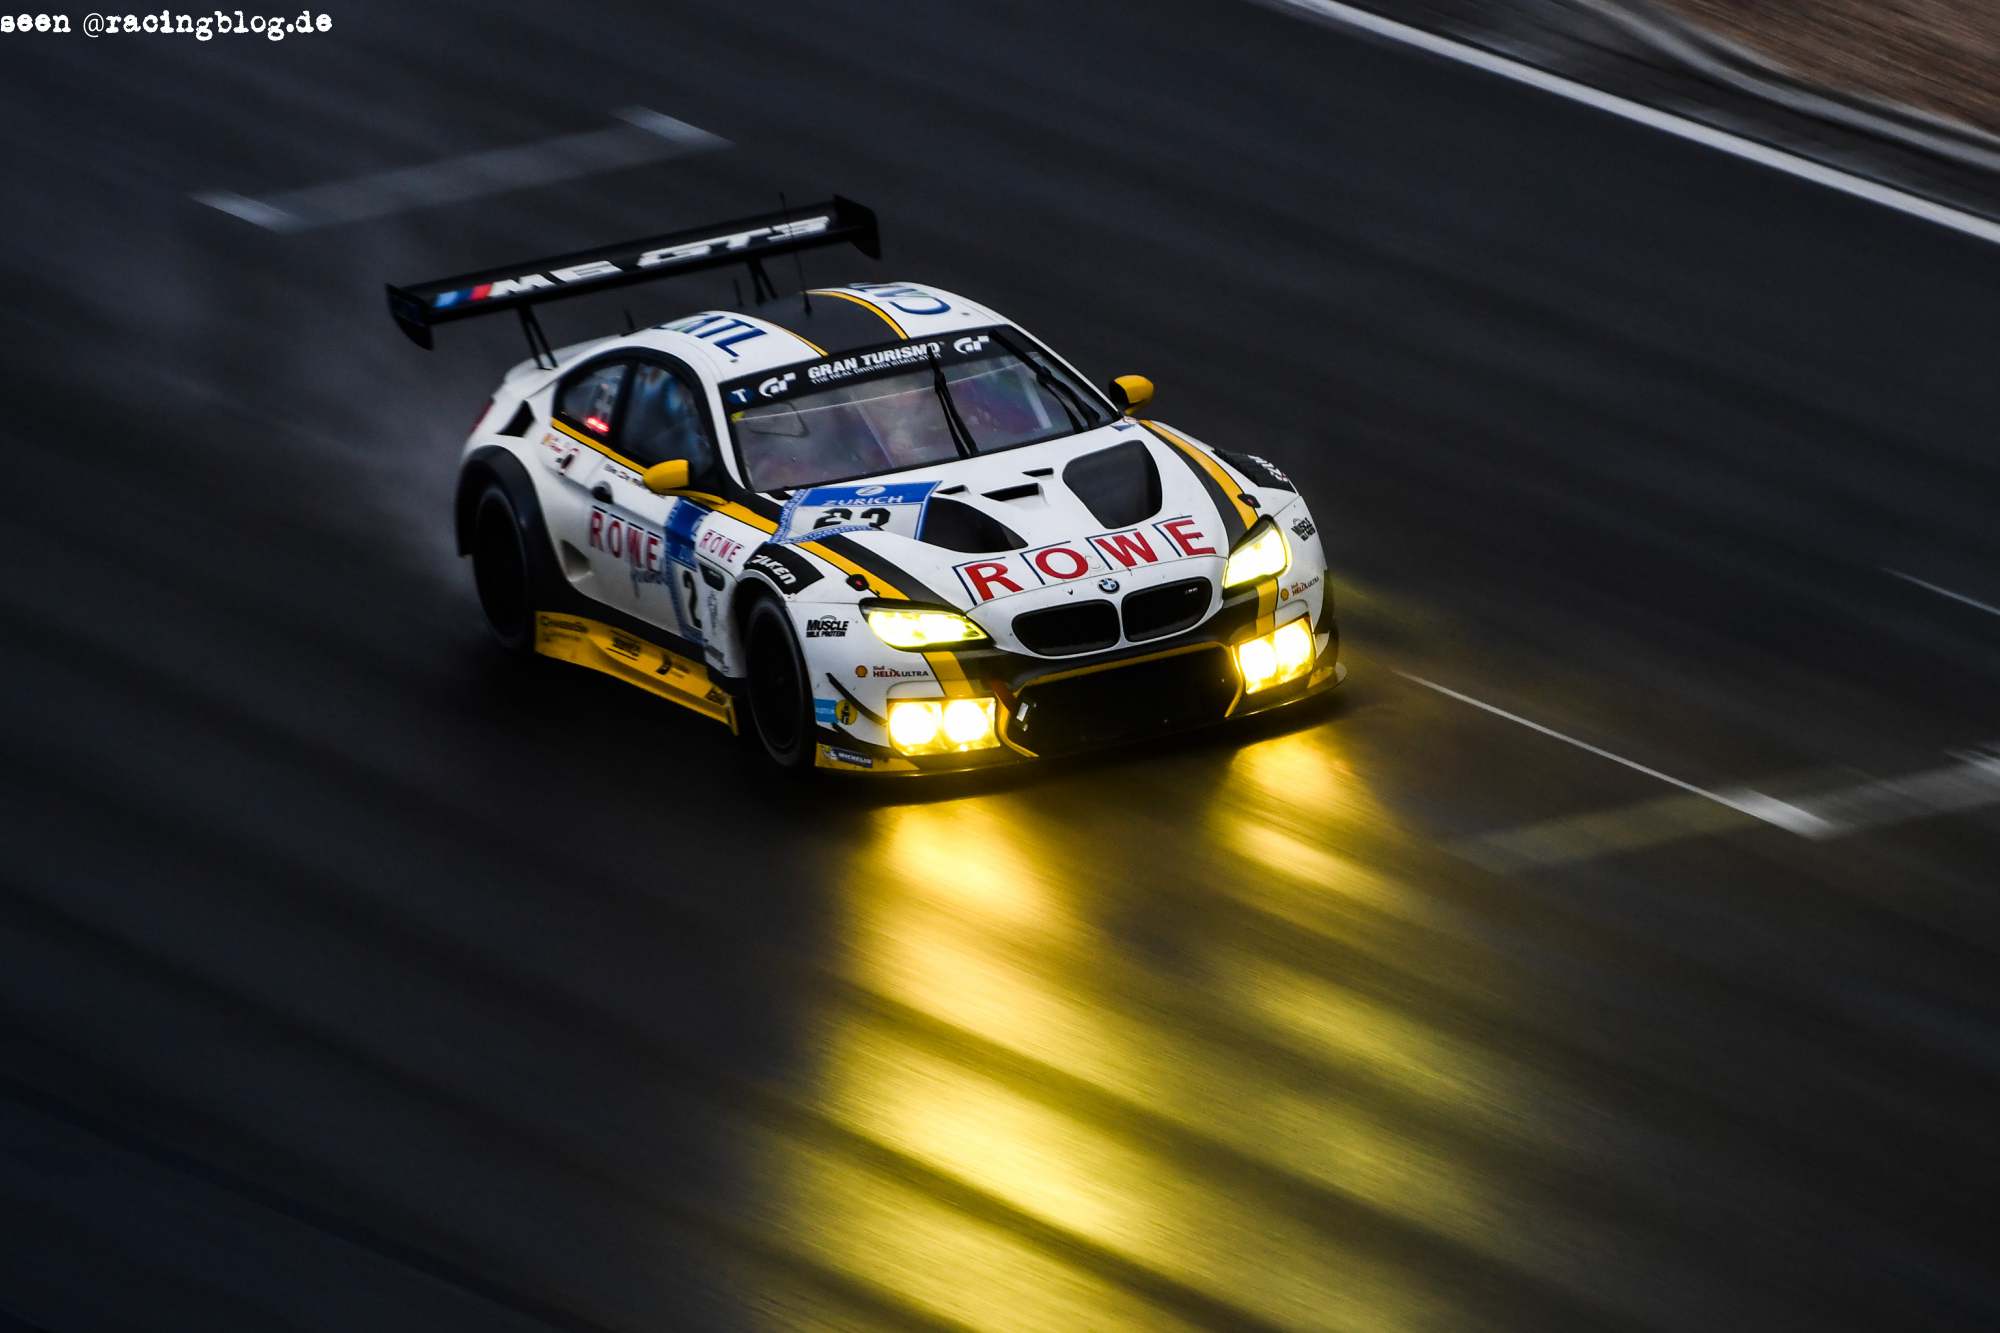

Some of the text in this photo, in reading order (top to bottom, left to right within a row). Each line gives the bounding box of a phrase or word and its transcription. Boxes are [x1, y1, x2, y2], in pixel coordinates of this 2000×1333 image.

[638, 215, 830, 268] GT3
[807, 342, 941, 380] GRAN TURISMO
[589, 510, 660, 574] ROWE
[699, 530, 743, 564] ROWE
[963, 519, 1217, 602] ROWE
[806, 619, 849, 631] MUSCLE
[872, 668, 929, 678] HELIX ULTRA
